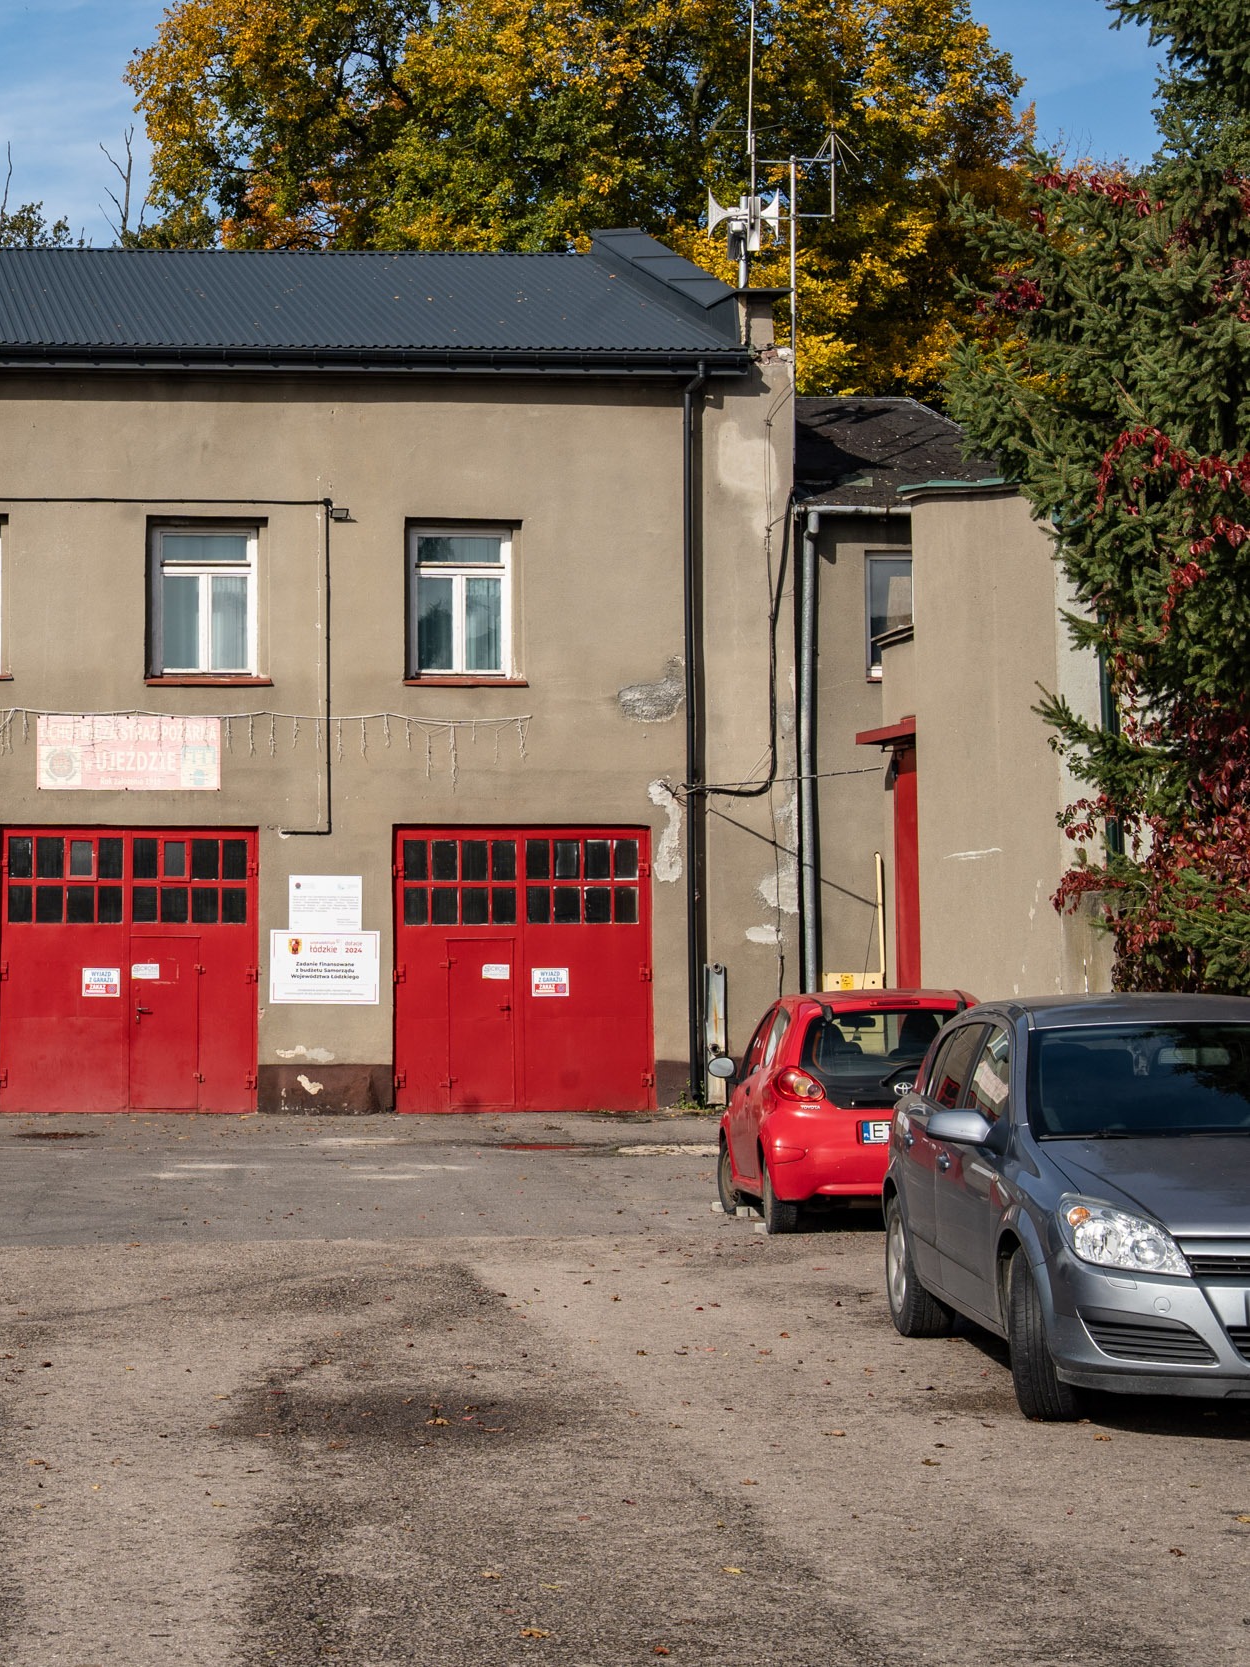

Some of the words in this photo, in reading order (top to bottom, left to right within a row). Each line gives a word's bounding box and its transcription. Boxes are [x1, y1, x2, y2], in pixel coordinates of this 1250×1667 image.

[120, 721, 158, 741] STRAŻ
[96, 745, 177, 771] UJEŹDZIE
[310, 945, 338, 953] łódzkie
